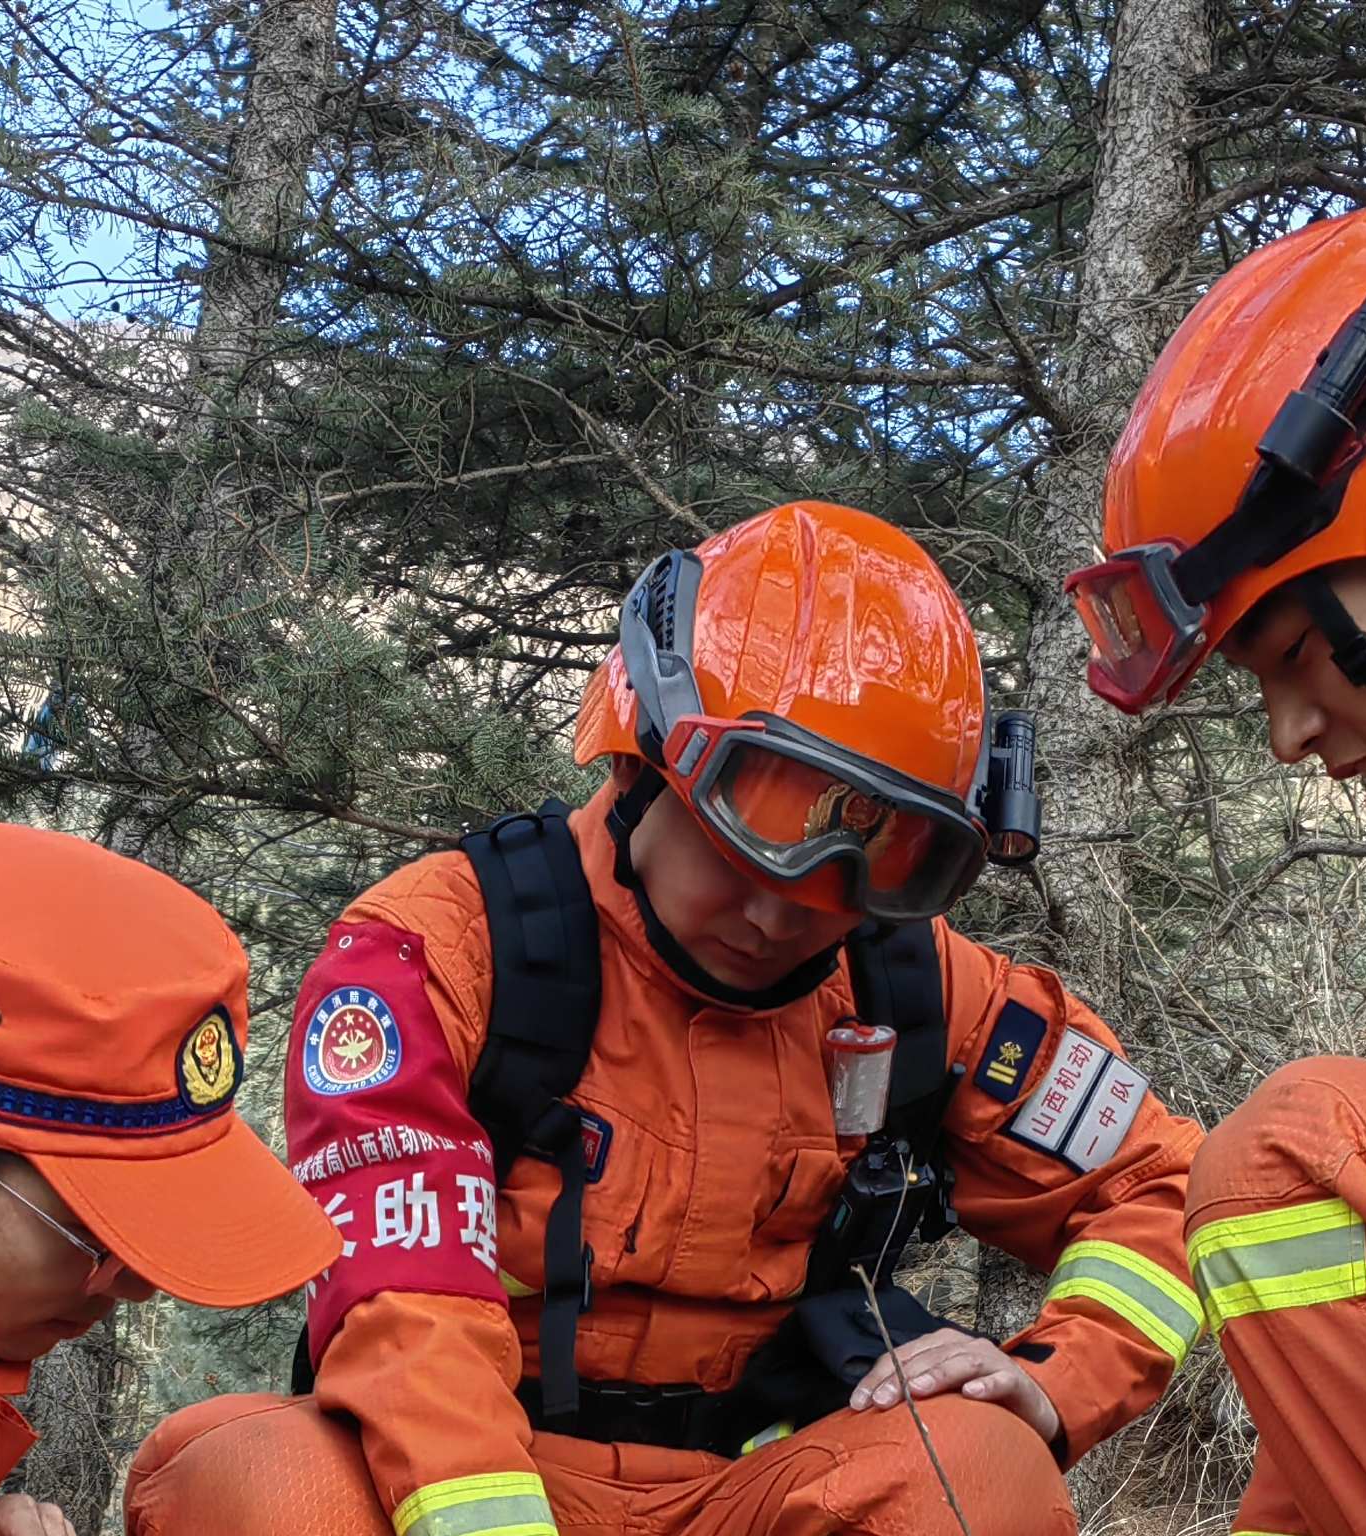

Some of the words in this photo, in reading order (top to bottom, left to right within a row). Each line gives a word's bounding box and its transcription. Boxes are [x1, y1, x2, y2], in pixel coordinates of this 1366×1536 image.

[309, 991, 393, 1047] 中国消防救援
[323, 1082, 343, 1093] FIRE
[345, 1081, 367, 1091] AND
[369, 1048, 397, 1085] RESCUE
[1030, 1043, 1094, 1137] 山西机动
[1087, 1078, 1135, 1157] 一中队
